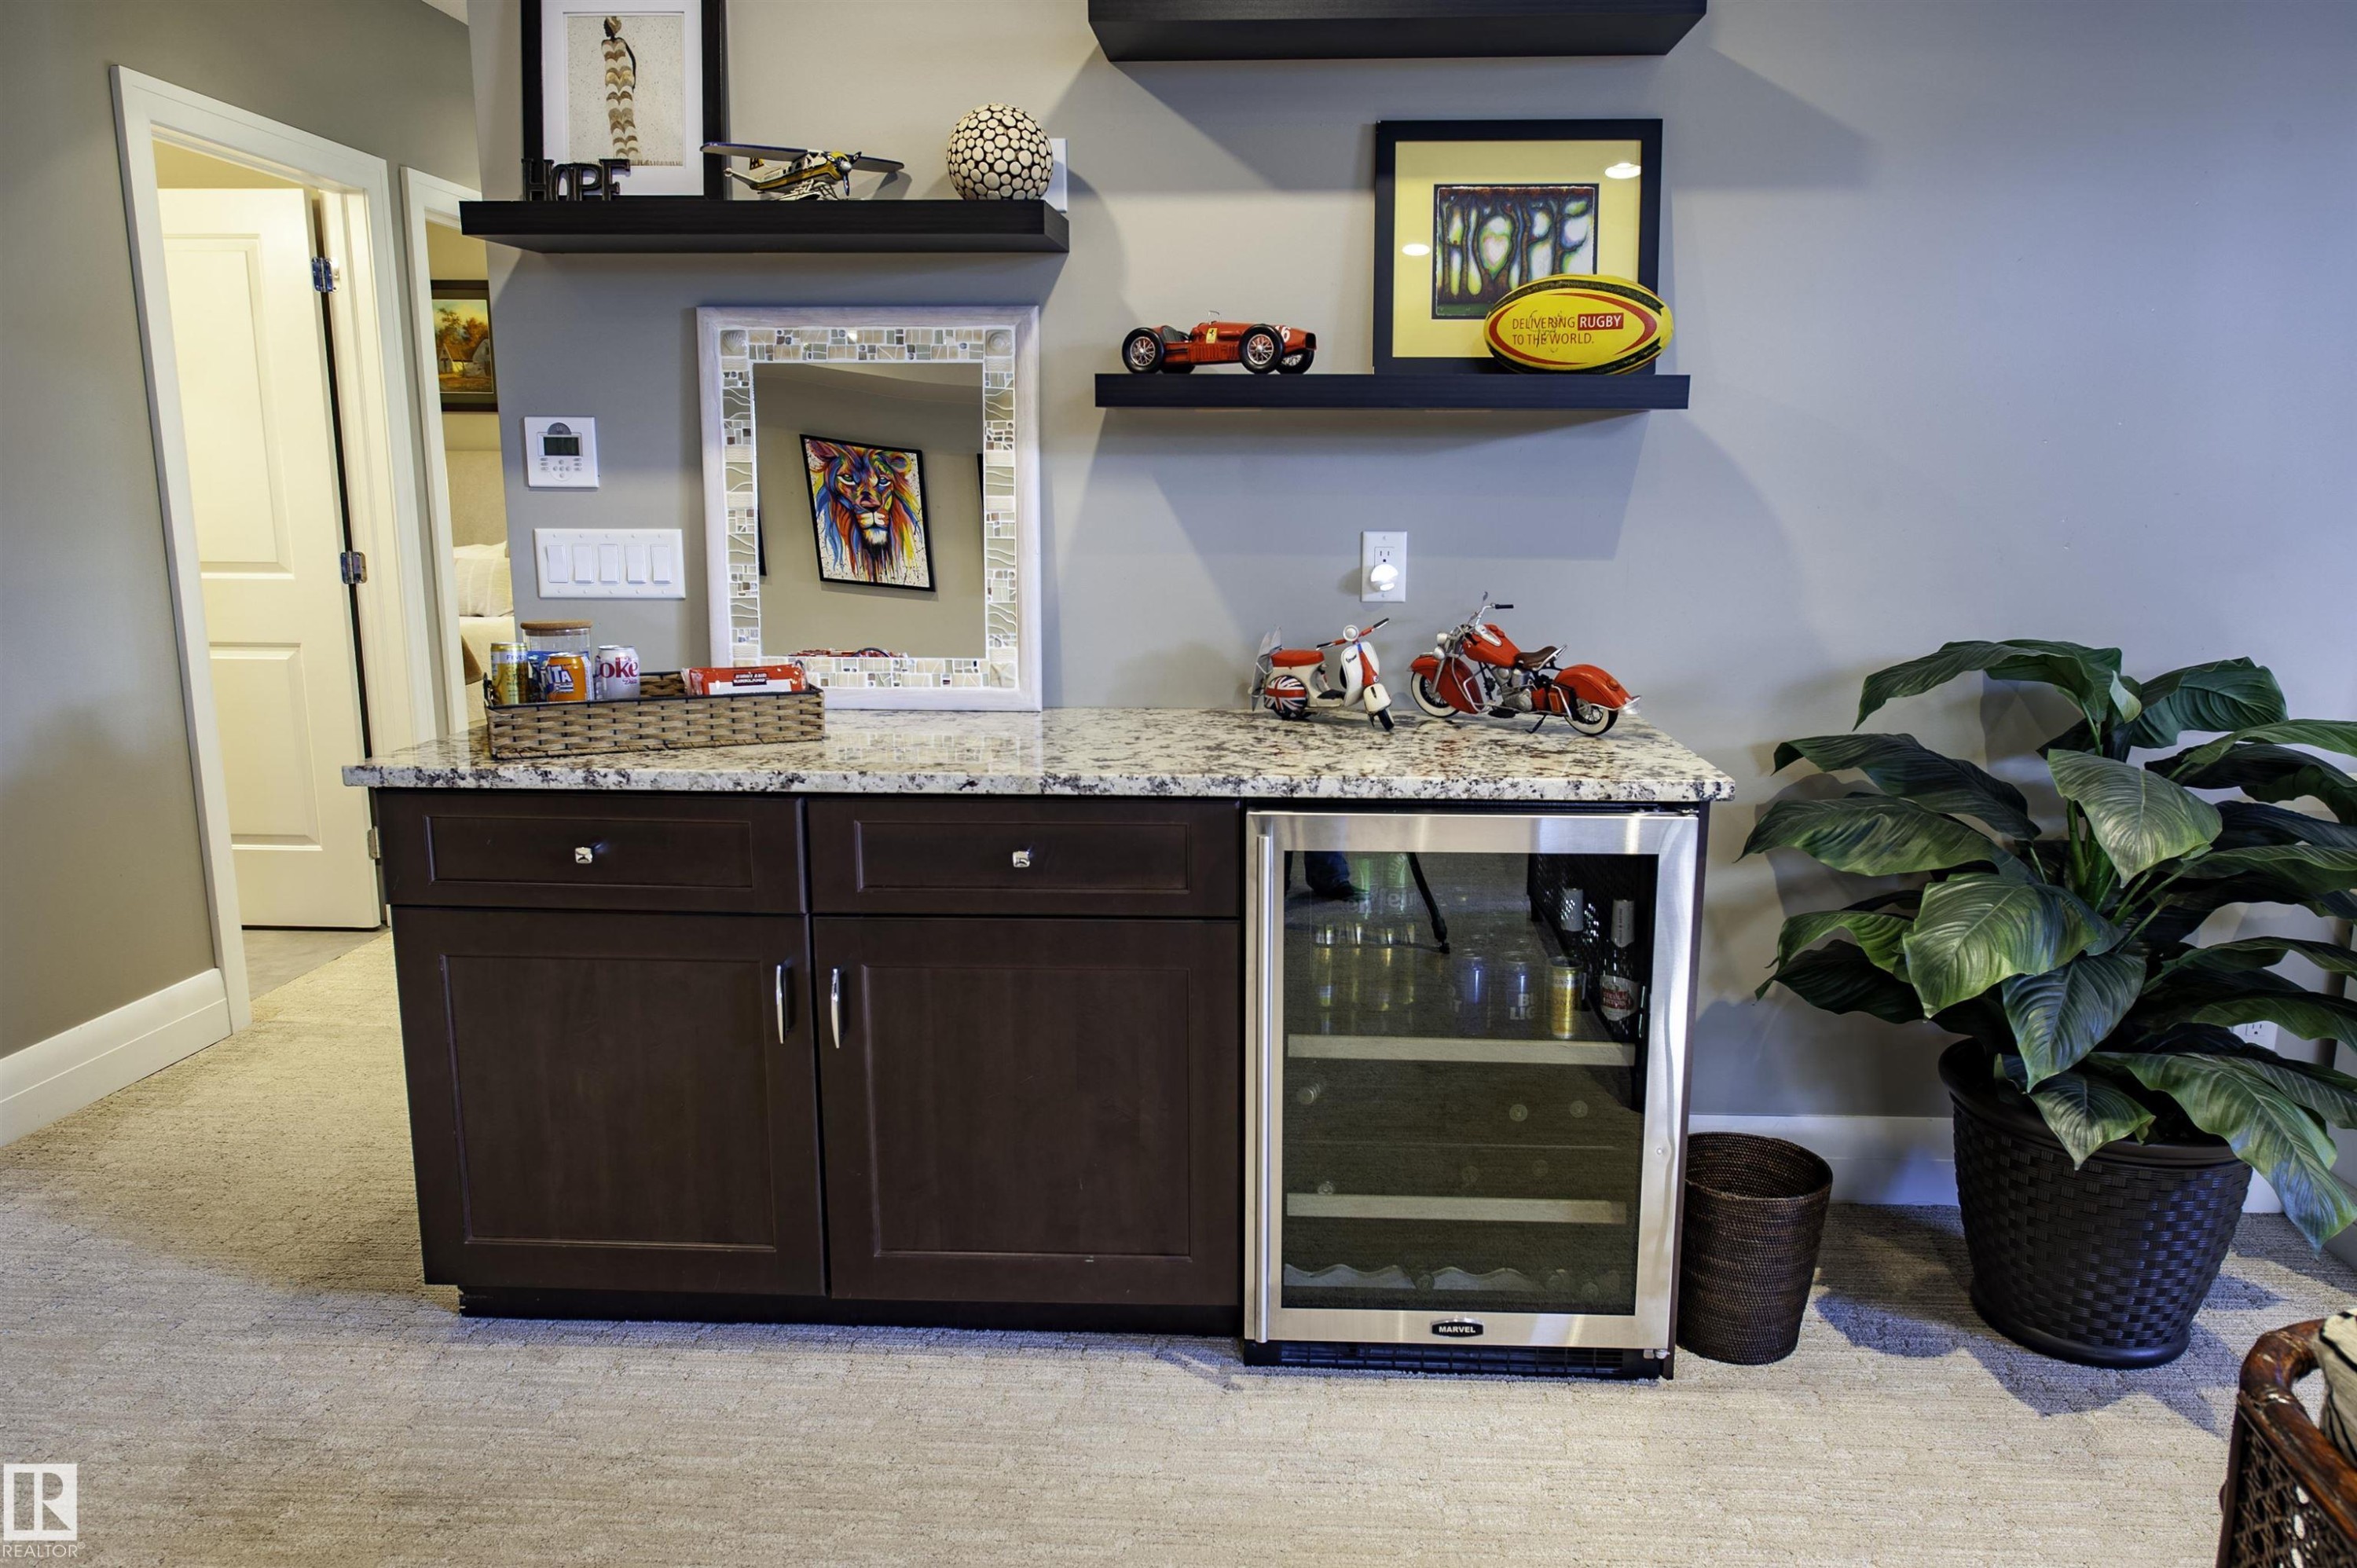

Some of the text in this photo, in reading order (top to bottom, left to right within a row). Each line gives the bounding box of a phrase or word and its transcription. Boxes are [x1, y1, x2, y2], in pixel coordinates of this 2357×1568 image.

[522, 159, 631, 201] HOPE
[1512, 314, 1622, 330] DELIVERING RUGBY
[1512, 332, 1595, 346] TO THE WORLD.
